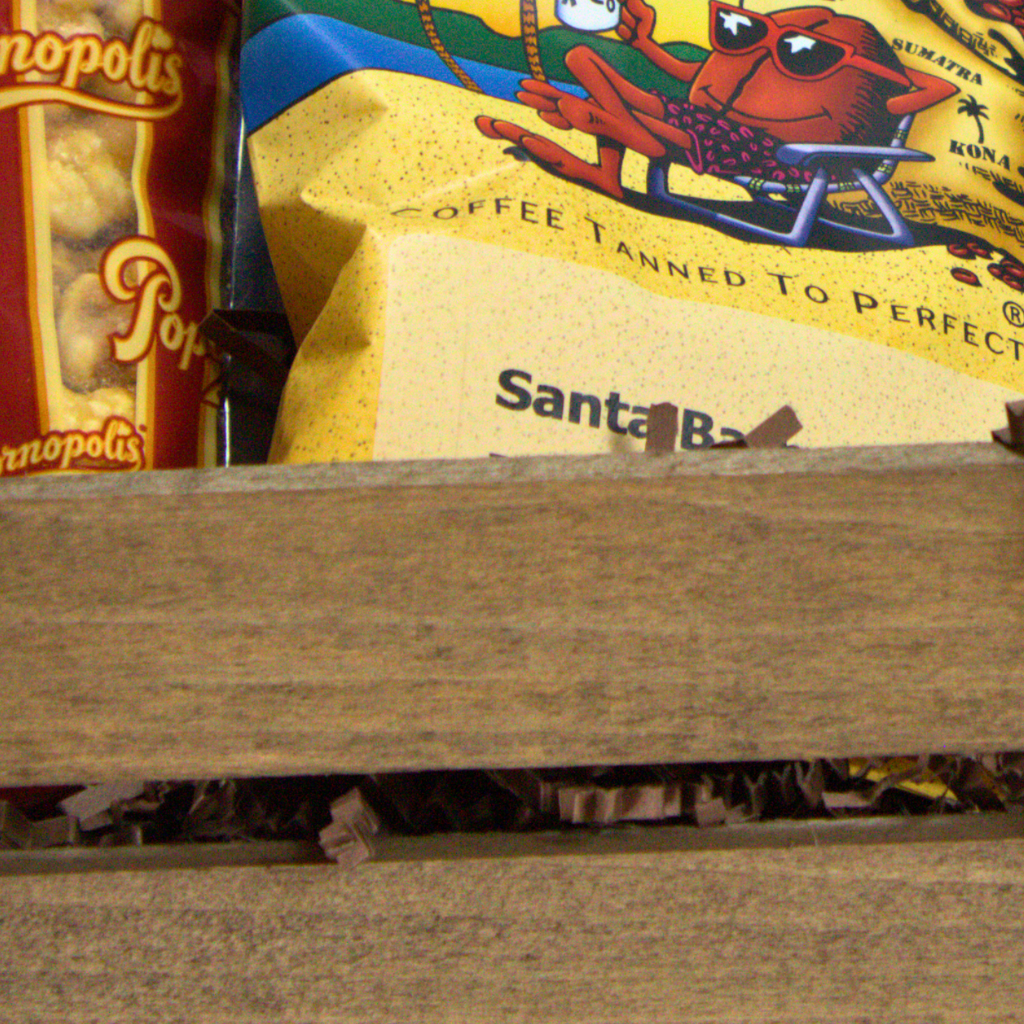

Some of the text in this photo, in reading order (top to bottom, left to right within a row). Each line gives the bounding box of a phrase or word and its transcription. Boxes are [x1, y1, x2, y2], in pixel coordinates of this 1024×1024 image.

[891, 38, 983, 86] SUMATRA
[949, 139, 1011, 171] KONA
[390, 198, 565, 231] COFFEE
[584, 216, 747, 288] TANNED
[767, 272, 829, 304] TO
[495, 368, 650, 439] Santa
